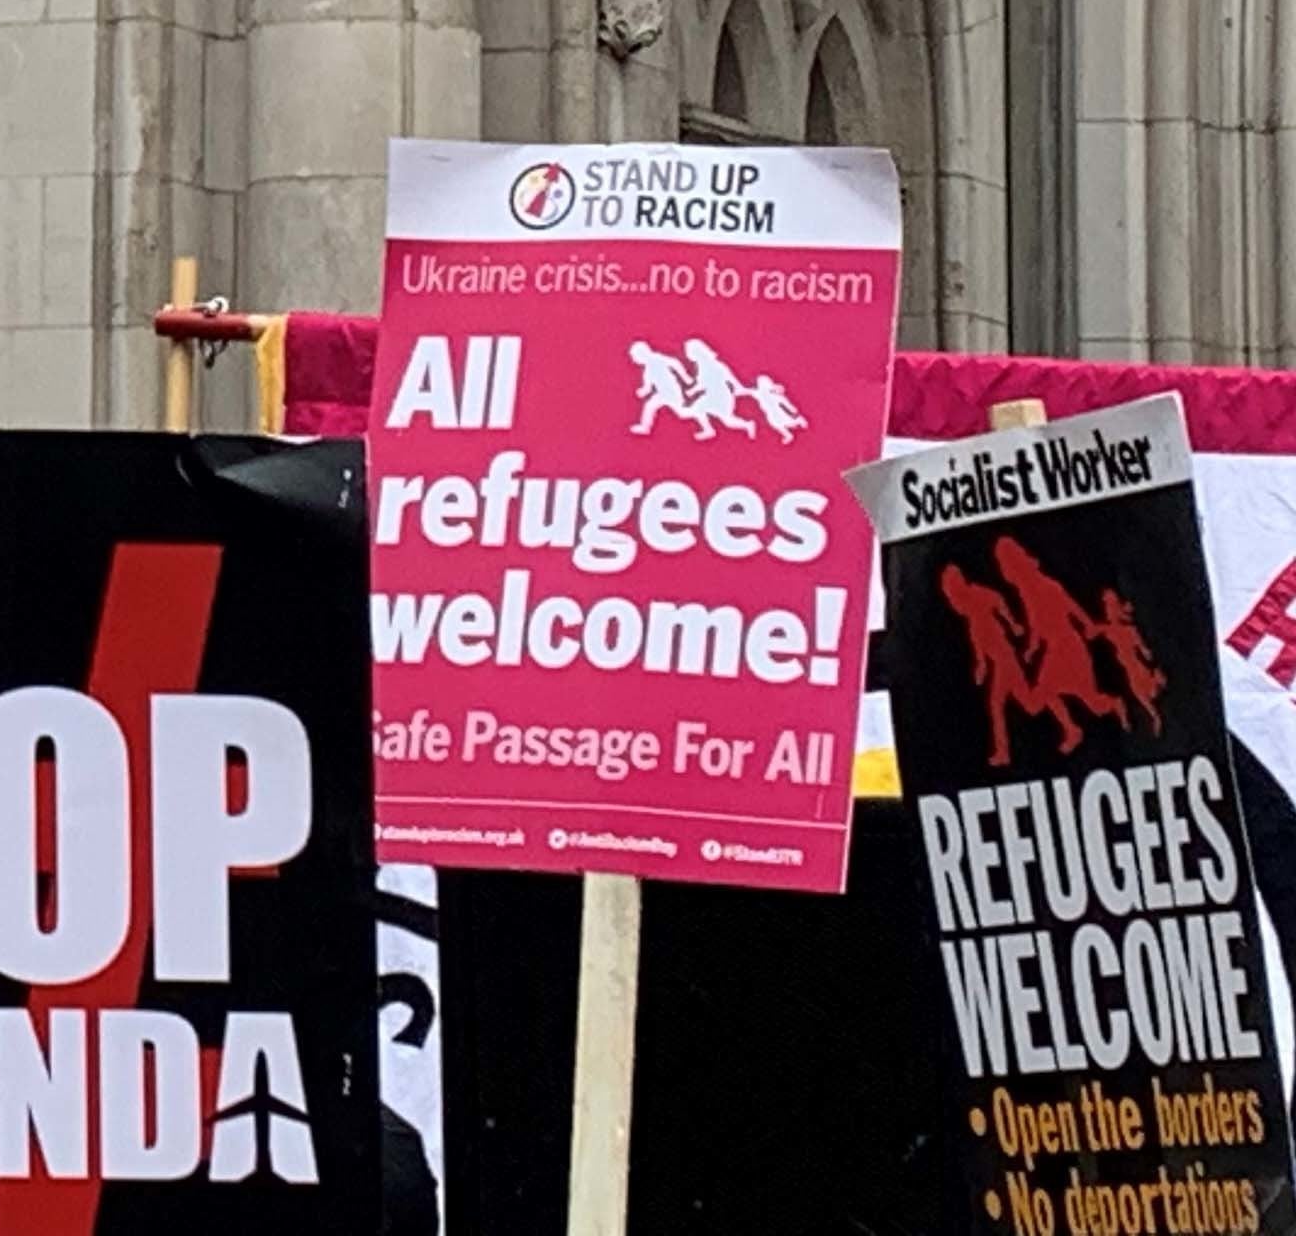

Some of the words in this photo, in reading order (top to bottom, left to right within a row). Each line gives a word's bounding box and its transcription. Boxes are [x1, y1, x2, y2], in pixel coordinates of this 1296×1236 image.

[583, 194, 624, 228] TO
[634, 195, 775, 233] RACISM
[584, 159, 699, 193] STAND
[710, 164, 759, 197] UP
[401, 255, 527, 295] Ukraine
[704, 264, 742, 299] to
[750, 262, 874, 304] racism
[385, 335, 522, 431] All
[375, 450, 829, 574] refugees
[902, 447, 1039, 529] Socialist
[1034, 428, 1153, 503] Worker
[370, 569, 848, 687] welcome!
[462, 710, 661, 781] Passage
[673, 720, 754, 780] For
[764, 729, 835, 786] All
[918, 754, 1238, 932] REFUGEES
[940, 910, 1261, 1078] WELCOME
[992, 1086, 1081, 1171] Open
[1079, 1079, 1145, 1152] the
[1151, 1072, 1265, 1148] borders
[1006, 1170, 1055, 1236] No
[1064, 1161, 1260, 1236] deportations
